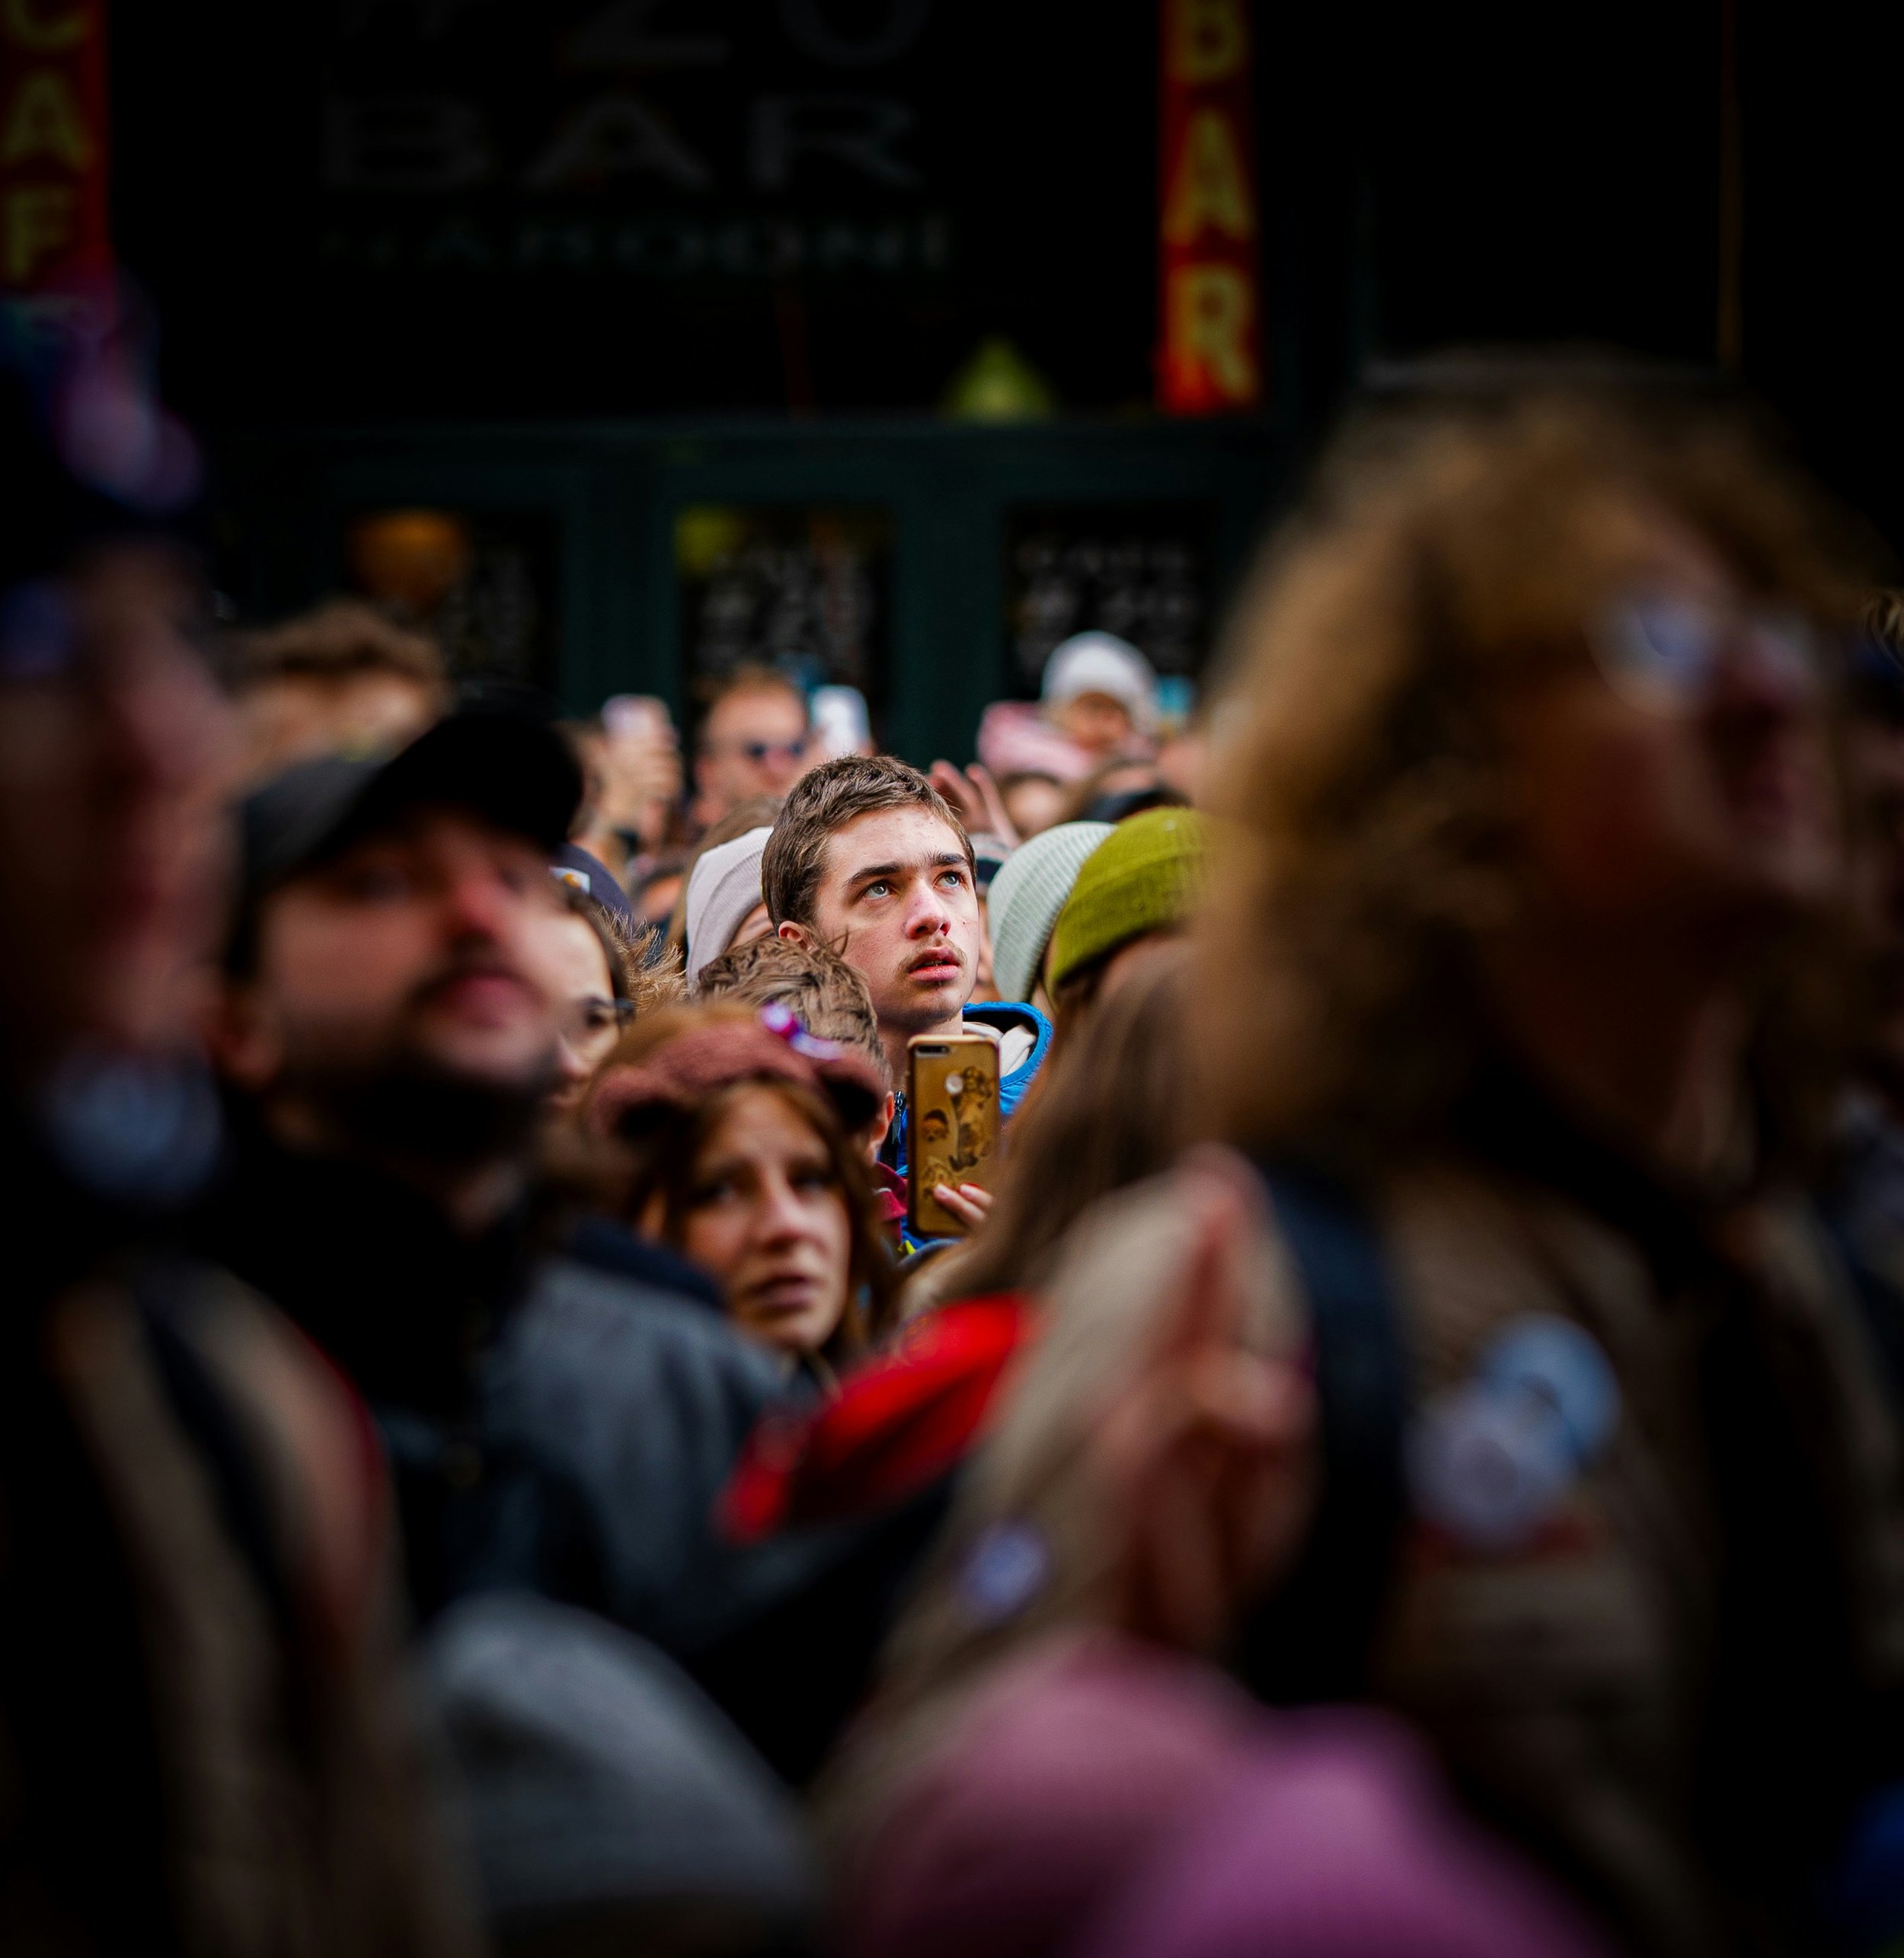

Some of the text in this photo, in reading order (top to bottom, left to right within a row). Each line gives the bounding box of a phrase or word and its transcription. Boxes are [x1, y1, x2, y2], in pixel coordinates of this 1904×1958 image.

[0, 0, 97, 286] CAF
[320, 91, 925, 194] BAR
[1162, 0, 1258, 404] BAR
